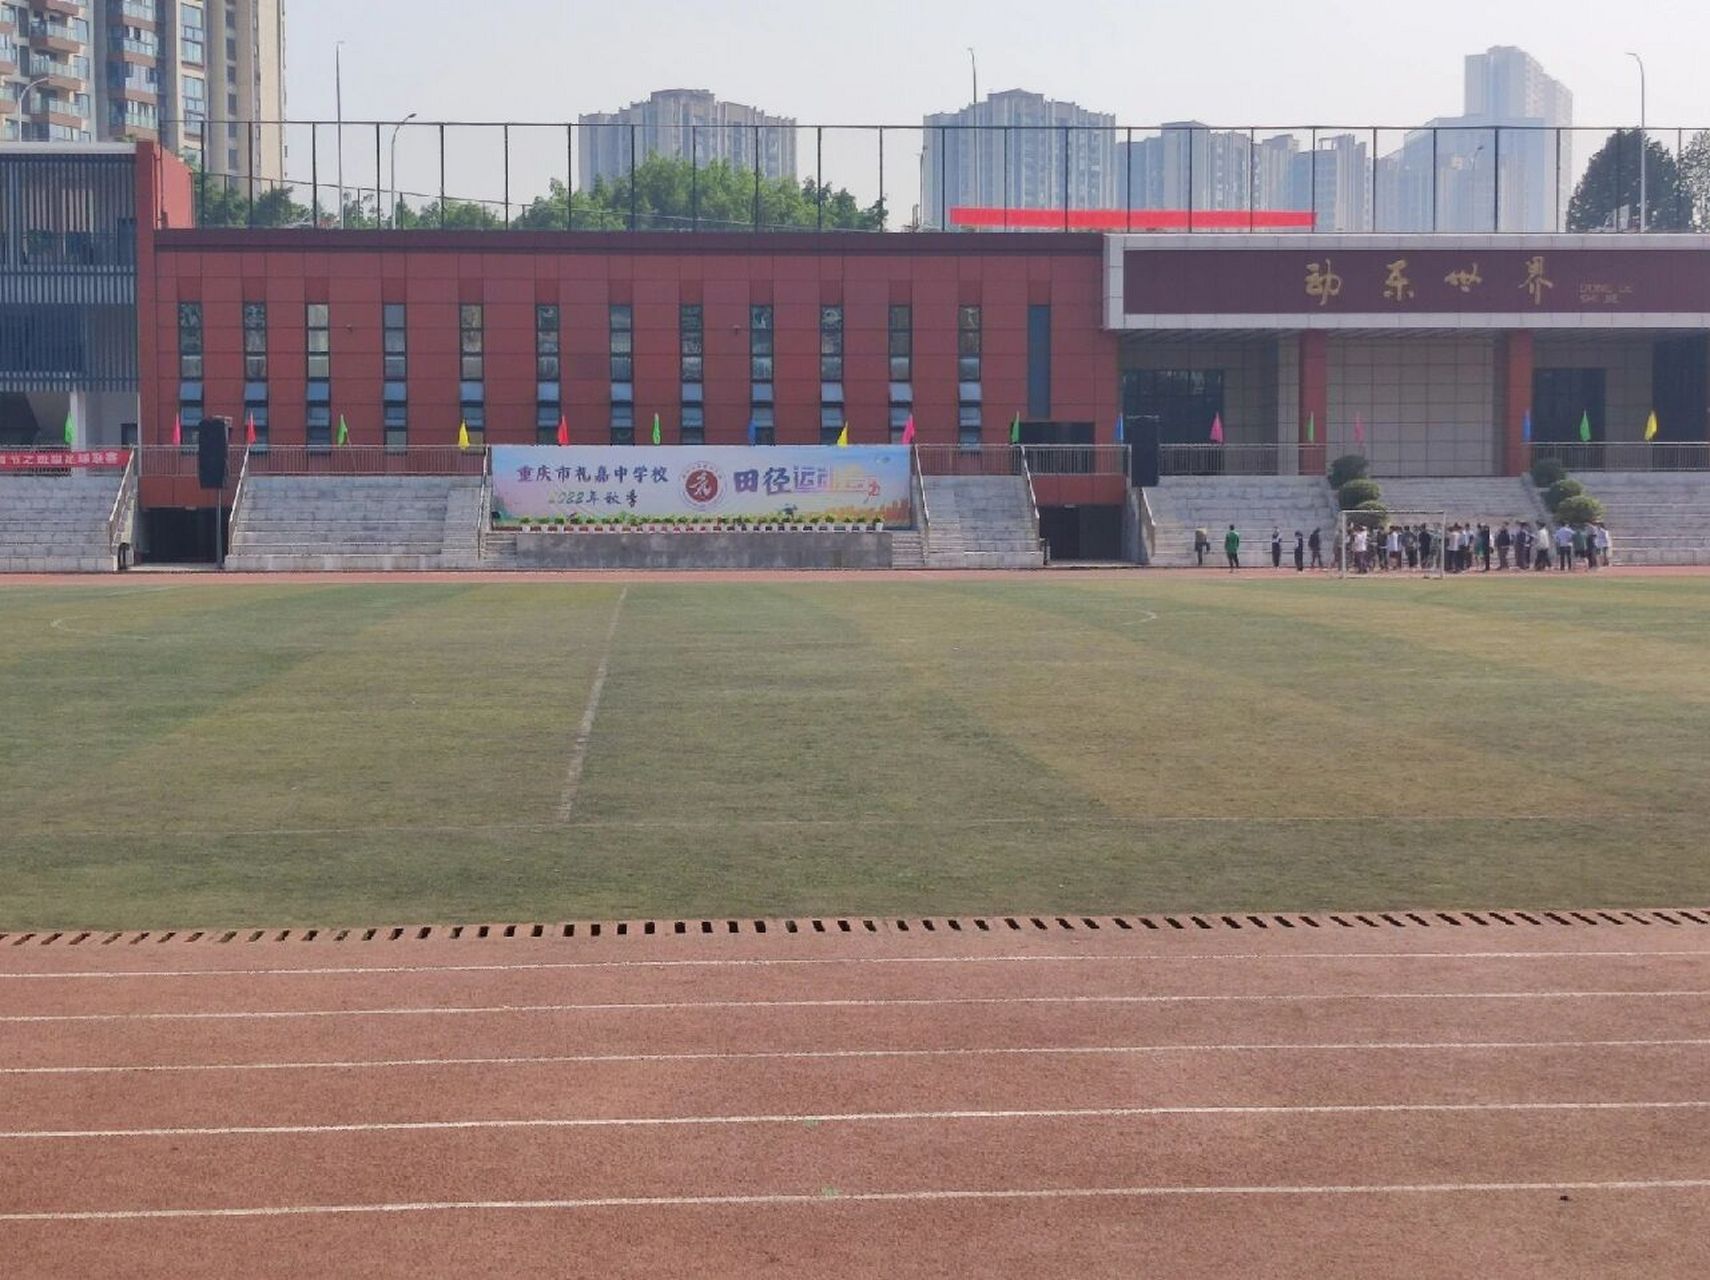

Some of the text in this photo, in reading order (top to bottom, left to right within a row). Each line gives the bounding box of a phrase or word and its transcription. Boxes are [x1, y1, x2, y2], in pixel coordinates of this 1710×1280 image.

[516, 465, 669, 483] 重庆市礼嘉中学校
